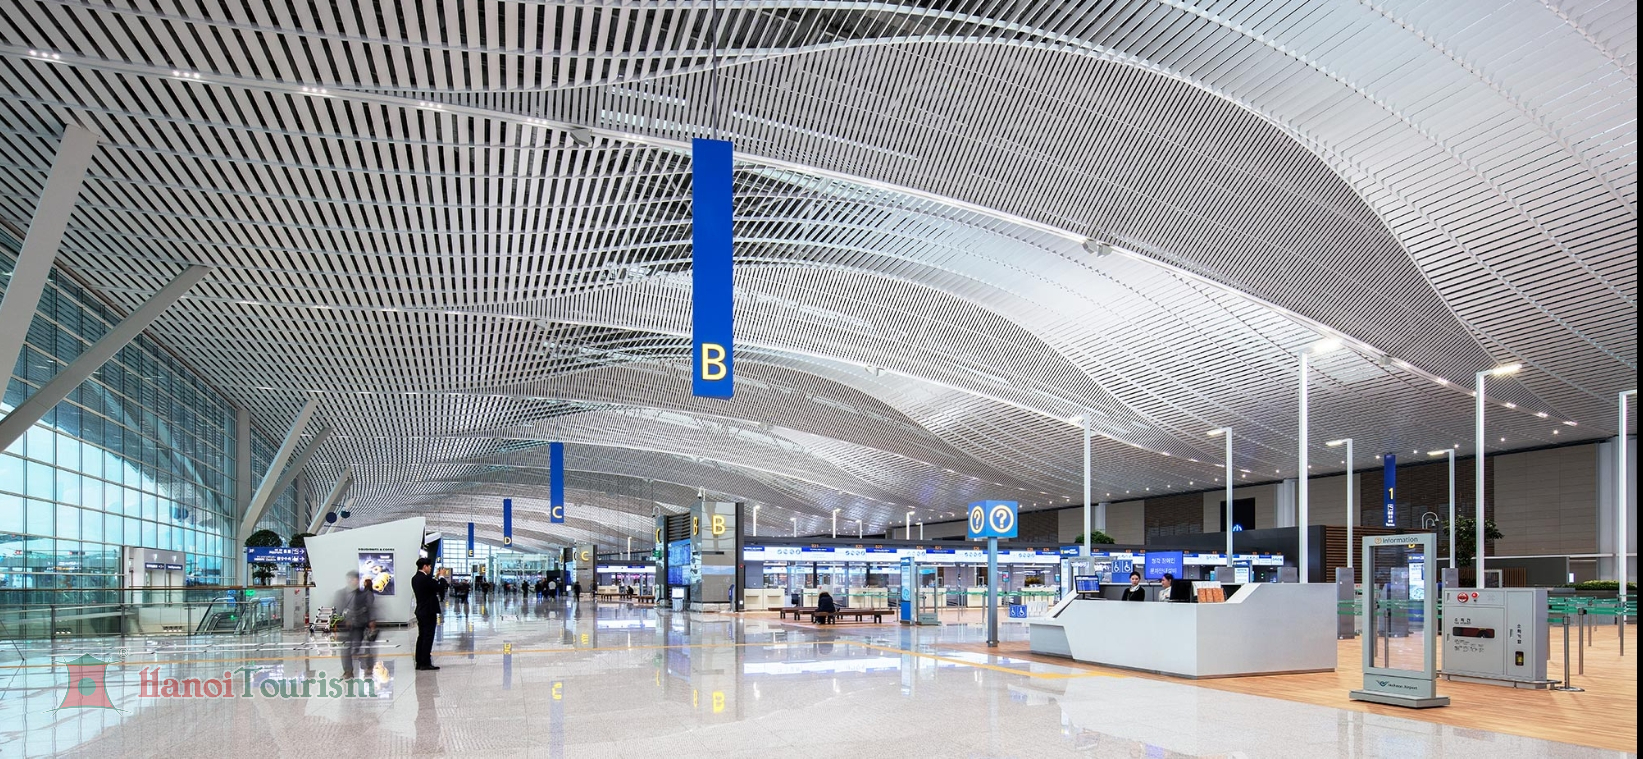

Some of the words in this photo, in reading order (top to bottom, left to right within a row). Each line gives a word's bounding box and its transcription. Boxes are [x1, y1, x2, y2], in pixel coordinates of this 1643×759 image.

[702, 343, 727, 380] B
[1388, 487, 1394, 500] 1
[552, 506, 563, 519] C
[693, 516, 698, 536] B
[712, 514, 726, 535] B
[504, 537, 512, 545] D
[1382, 536, 1419, 544] Information
[581, 551, 589, 561] C
